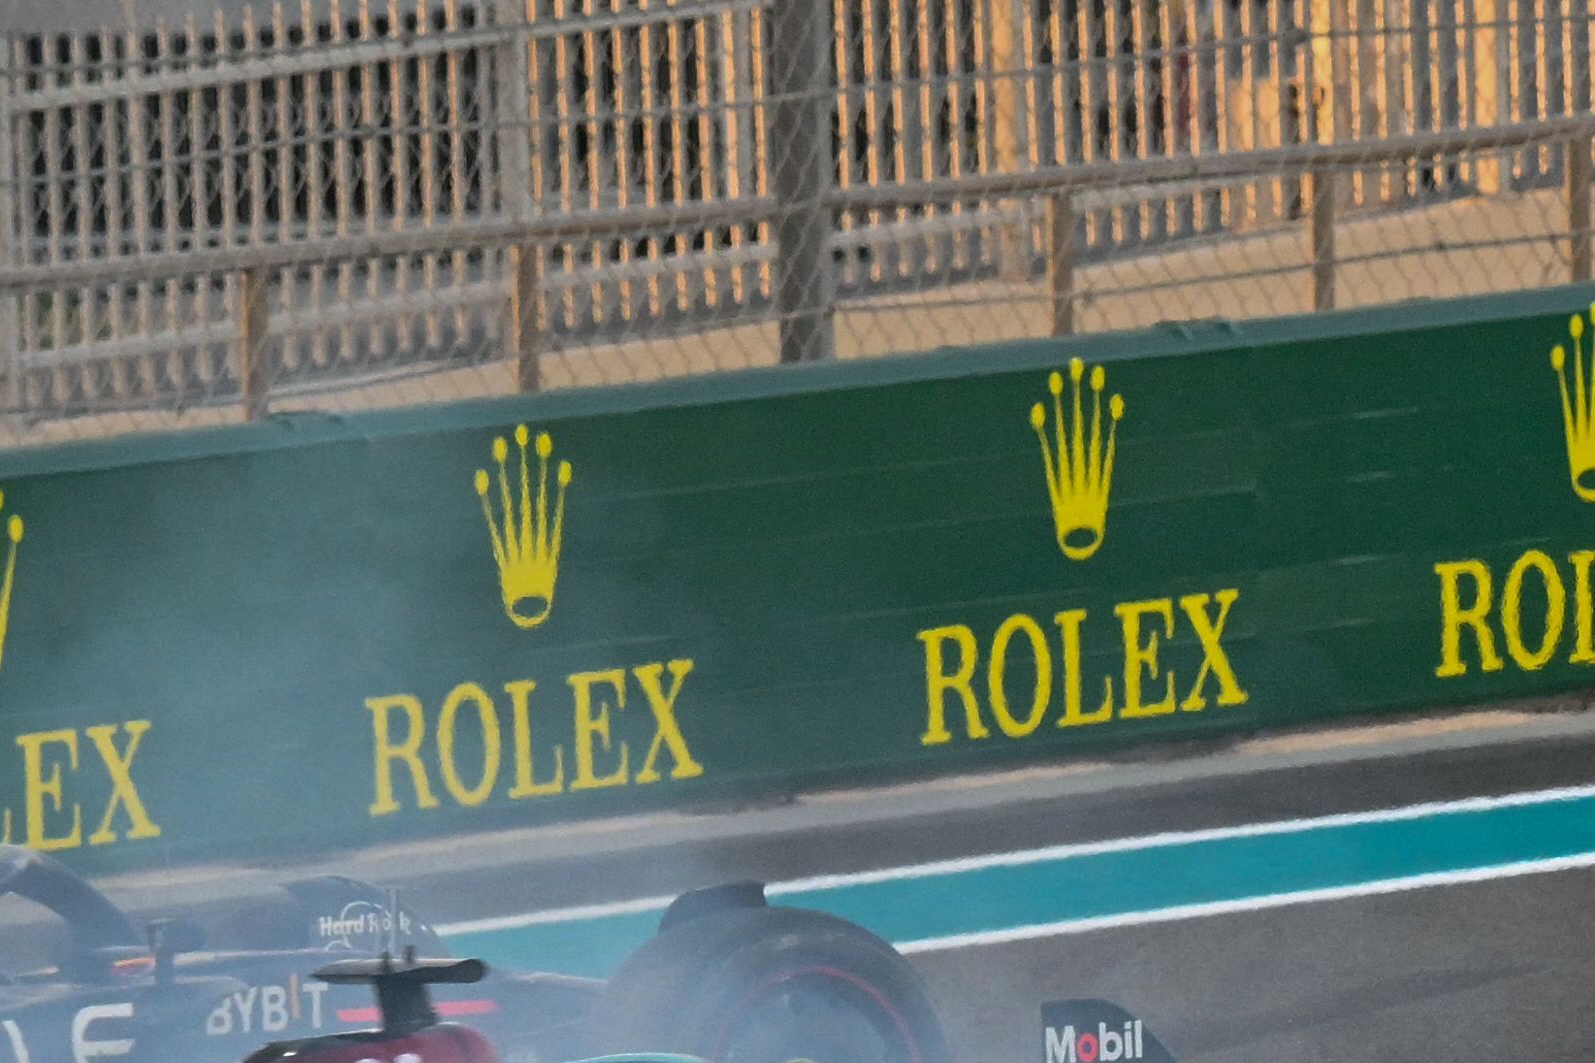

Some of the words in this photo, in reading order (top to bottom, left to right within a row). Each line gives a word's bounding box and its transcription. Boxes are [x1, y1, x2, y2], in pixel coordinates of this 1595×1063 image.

[916, 588, 1249, 745] ROLEX
[364, 659, 704, 818] ROLEX
[319, 913, 365, 937] Hard
[367, 910, 412, 936] Rok
[206, 973, 330, 1035] BYBIT
